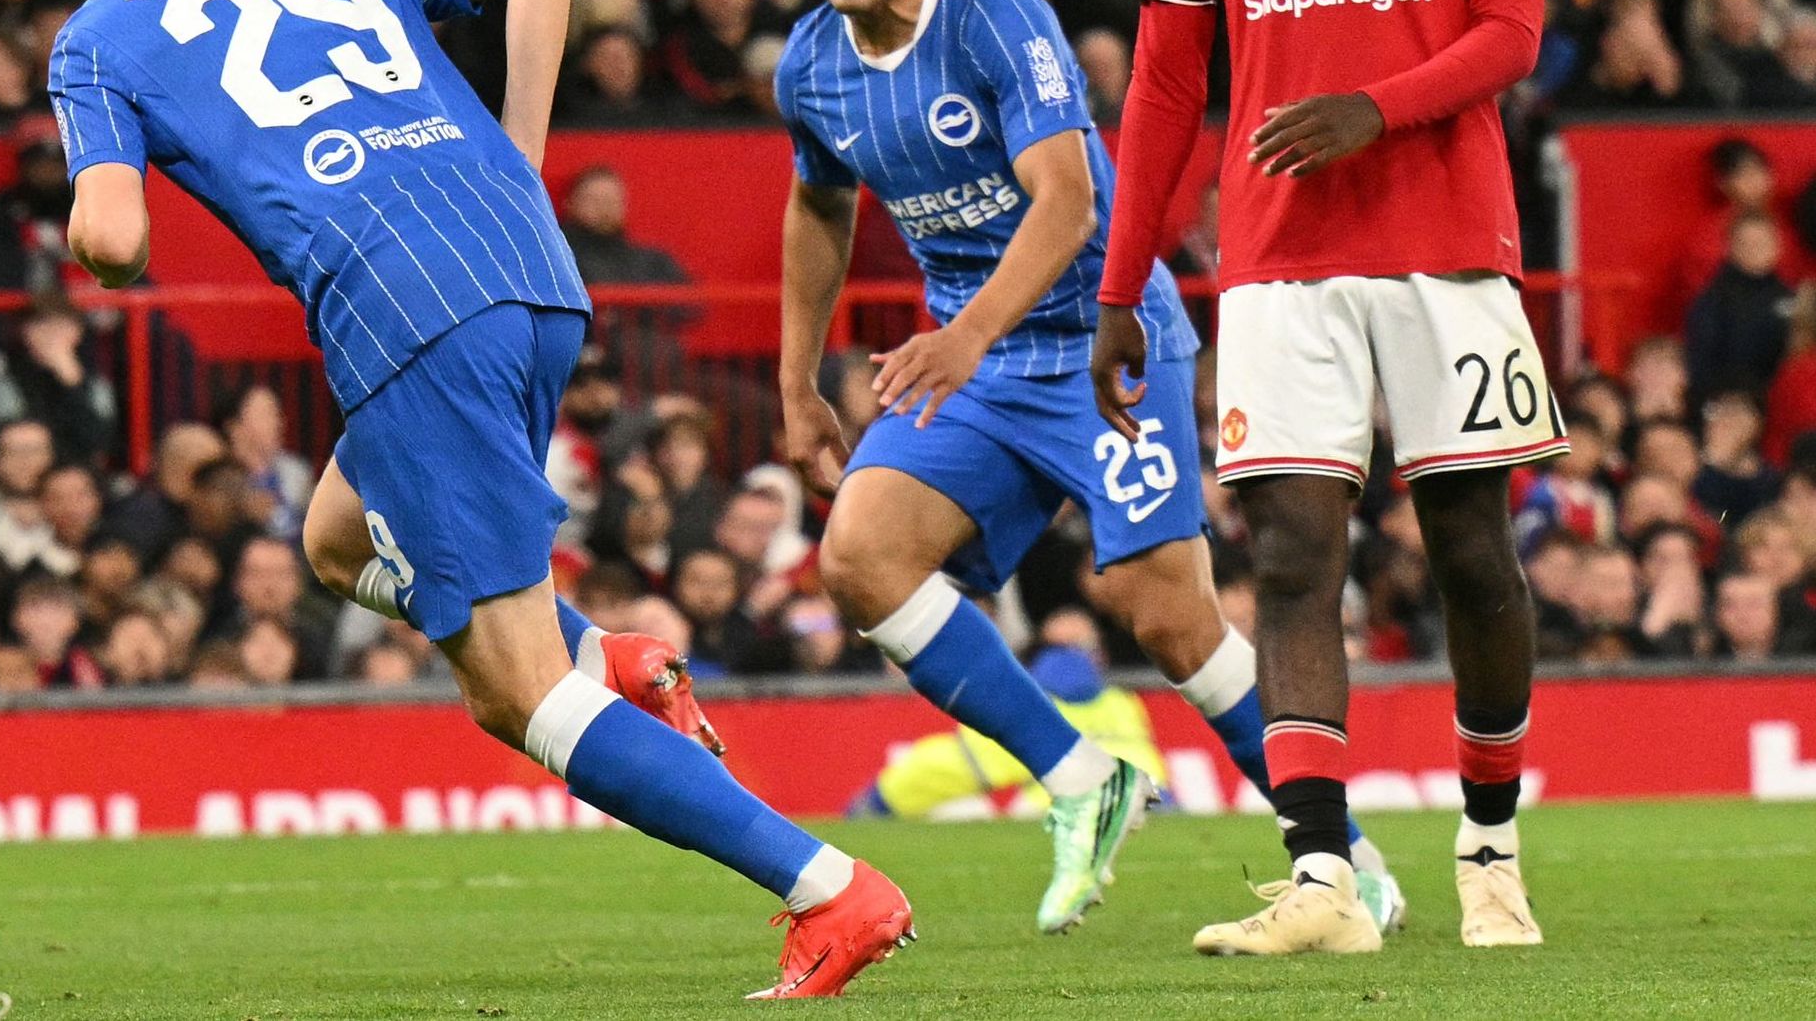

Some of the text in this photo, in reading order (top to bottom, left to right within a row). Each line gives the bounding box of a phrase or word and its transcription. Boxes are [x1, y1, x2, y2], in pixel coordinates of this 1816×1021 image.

[883, 172, 1004, 219] MERICAN
[900, 185, 1020, 240] XPRESS
[1453, 347, 1539, 434] 26
[1093, 418, 1178, 504] 25
